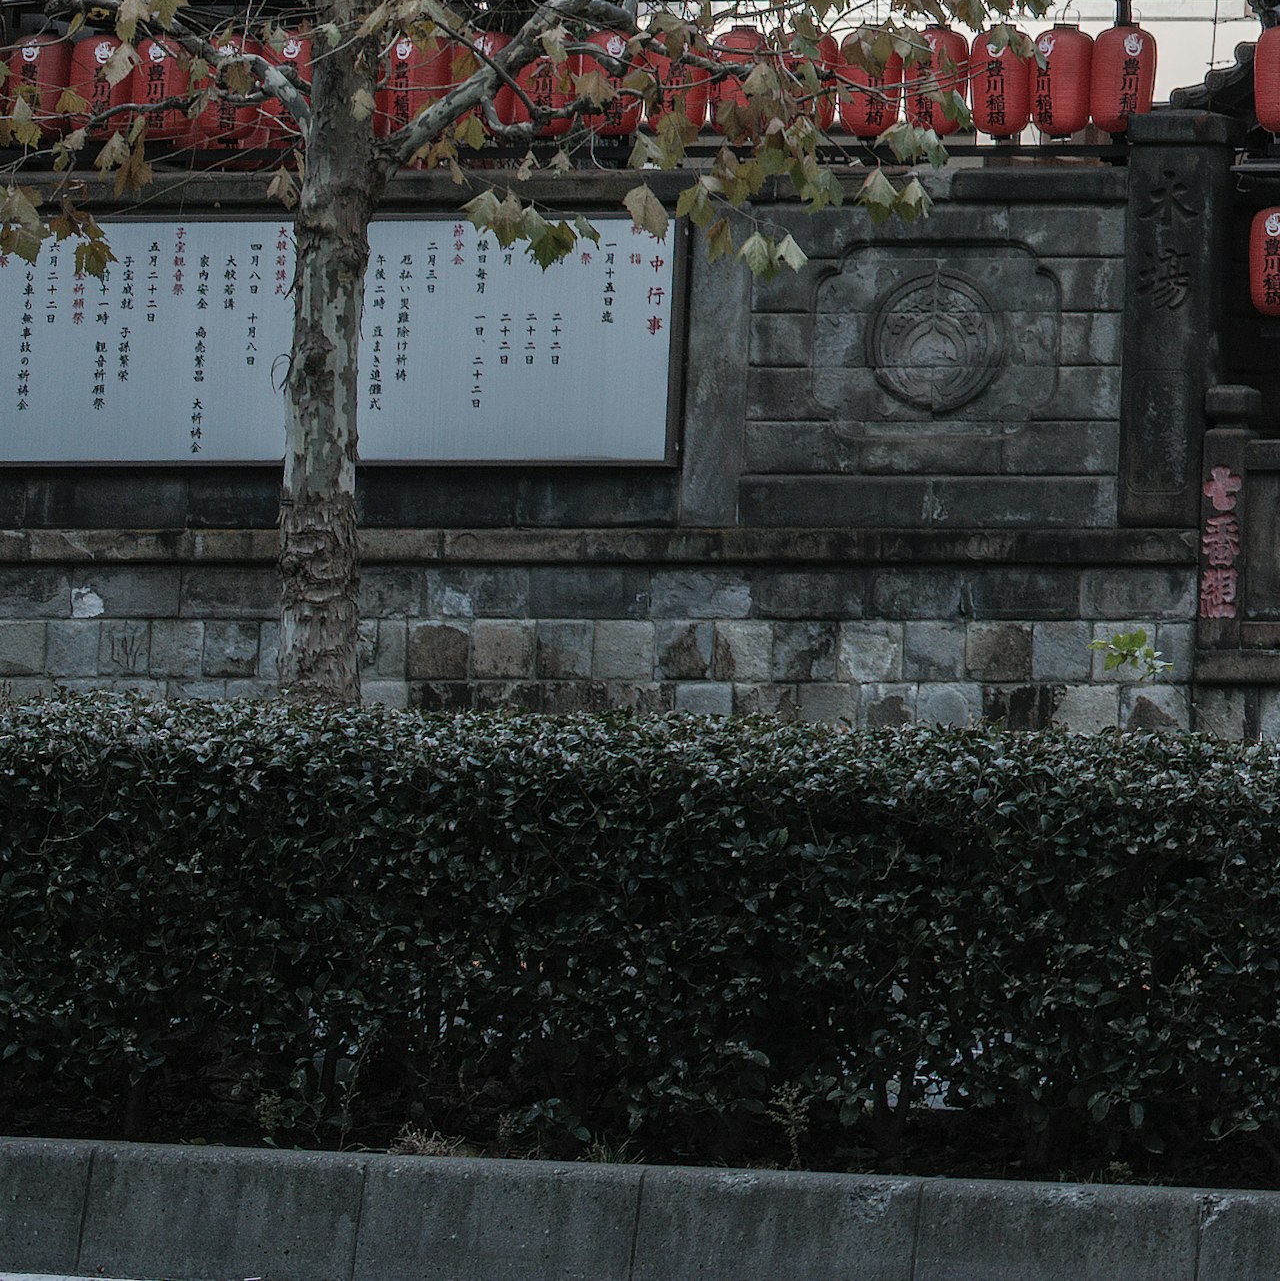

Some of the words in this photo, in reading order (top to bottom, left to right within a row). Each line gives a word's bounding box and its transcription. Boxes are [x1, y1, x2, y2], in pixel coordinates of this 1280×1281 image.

[986, 61, 1005, 126] 豊川稲荷
[172, 226, 187, 296] 子宝観音祭
[250, 243, 262, 294] 四月八日
[275, 226, 289, 296] 大般若講式
[426, 242, 438, 294] 二月三日
[451, 224, 465, 266] 節分会
[476, 240, 489, 294] 縁日毎月
[46, 242, 61, 323] 六月二十二日
[120, 256, 135, 309] 子宝成就
[147, 242, 160, 322] 五月二十二日
[197, 255, 210, 309] 家内安全
[224, 255, 237, 310] 大般若講
[373, 254, 386, 309] 午後二時
[601, 243, 617, 324] 一月十五日迄
[118, 327, 131, 382] 子孫繁栄
[193, 326, 206, 383] 商売繁昌
[246, 312, 258, 366] 十月八日
[499, 313, 511, 365] 二十二日
[524, 313, 537, 365] 二十二日
[550, 313, 563, 365] 二十二日
[1200, 464, 1242, 618] 七番組
